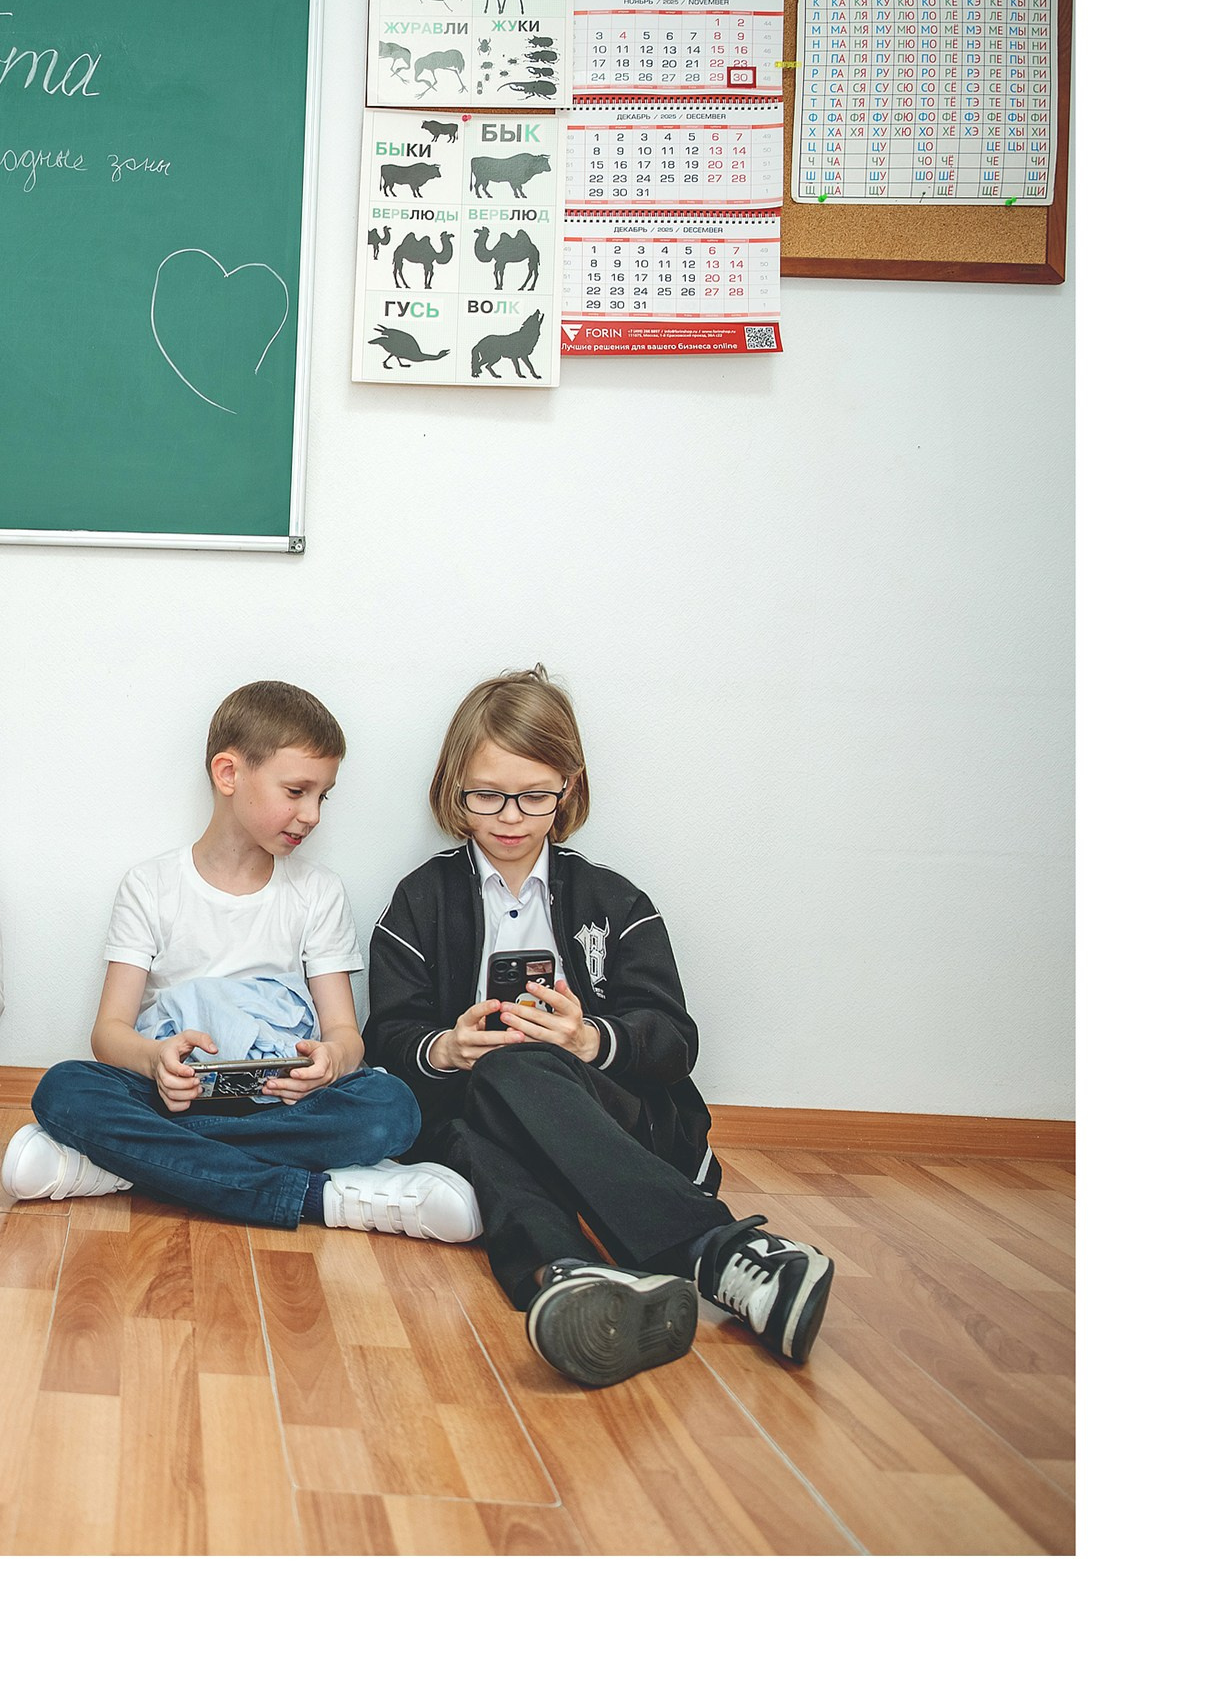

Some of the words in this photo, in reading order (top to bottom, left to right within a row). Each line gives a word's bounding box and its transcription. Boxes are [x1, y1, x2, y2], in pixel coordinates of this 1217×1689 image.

[813, 12, 820, 20] Л
[832, 11, 845, 20] ЛА
[878, 11, 890, 20] ЛУ
[384, 21, 469, 35] ЖУРАВЛИ
[491, 20, 540, 33] ЖУКИ
[738, 19, 744, 27] 2
[812, 25, 821, 34] М
[831, 26, 846, 34] МА
[876, 25, 891, 34] МУ
[596, 32, 603, 40] 3
[643, 32, 650, 40] 5
[666, 32, 673, 40] 6
[690, 32, 697, 40] 7
[714, 32, 721, 40] 8
[738, 32, 744, 40] 9
[813, 40, 820, 48] Н
[832, 39, 846, 48] НА
[876, 39, 890, 48] НУ
[617, 45, 628, 53] 11
[640, 46, 653, 54] 12
[663, 46, 677, 54] 13
[687, 46, 700, 54] 14
[735, 46, 747, 54] 16
[812, 54, 820, 63] П
[831, 53, 845, 63] ПА
[876, 52, 890, 63] ПУ
[593, 59, 605, 67] 17
[616, 59, 629, 67] 18
[640, 59, 653, 67] 19
[662, 60, 677, 68] 20
[686, 60, 698, 68] 21
[710, 59, 724, 67] 22
[591, 73, 605, 81] 24
[615, 73, 629, 81] 25
[639, 73, 652, 81] 26
[662, 74, 676, 82] 27
[710, 73, 724, 81] 29
[733, 73, 748, 81] 30
[812, 69, 819, 78] Р
[832, 68, 844, 77] РА
[876, 67, 888, 77] РУ
[811, 84, 818, 93] С
[829, 83, 844, 93] СА
[875, 83, 889, 92] СУ
[811, 98, 817, 107] Т
[832, 98, 842, 108] ТА
[876, 97, 888, 107] ТУ
[808, 112, 818, 123] Ф
[827, 112, 843, 122] ФА
[872, 112, 888, 122] ФУ
[481, 123, 541, 143] БЫК
[617, 133, 624, 141] 2
[641, 133, 648, 141] 3
[664, 133, 671, 141] 4
[689, 133, 695, 141] 5
[712, 133, 719, 141] 6
[736, 133, 742, 141] 7
[808, 128, 816, 137] Х
[828, 128, 842, 137] ХА
[872, 127, 887, 137] ХУ
[375, 141, 432, 158] БЫКИ
[593, 147, 600, 155] 8
[617, 147, 624, 155] 9
[638, 147, 652, 155] 10
[685, 147, 699, 155] 12
[709, 147, 722, 155] 13
[808, 142, 816, 152] Ц
[826, 142, 842, 151] ЦА
[872, 142, 886, 151] ЦУ
[808, 157, 816, 166] Ч
[827, 157, 841, 166] ЧА
[872, 157, 886, 167] ЧУ
[806, 171, 816, 180] Ш
[825, 171, 841, 181] ША
[870, 171, 886, 182] ШУ
[805, 185, 816, 197] Щ
[823, 185, 842, 197] ЩА
[868, 185, 886, 197] ЩУ
[372, 207, 459, 222] ВЕРБЛЮДЫ
[468, 208, 550, 224] ВЕРБЛЮД
[384, 300, 440, 318] ГУСЬ
[467, 300, 520, 315] ВОЛК
[586, 328, 623, 338] FORIN
[561, 343, 592, 352] Лучшие
